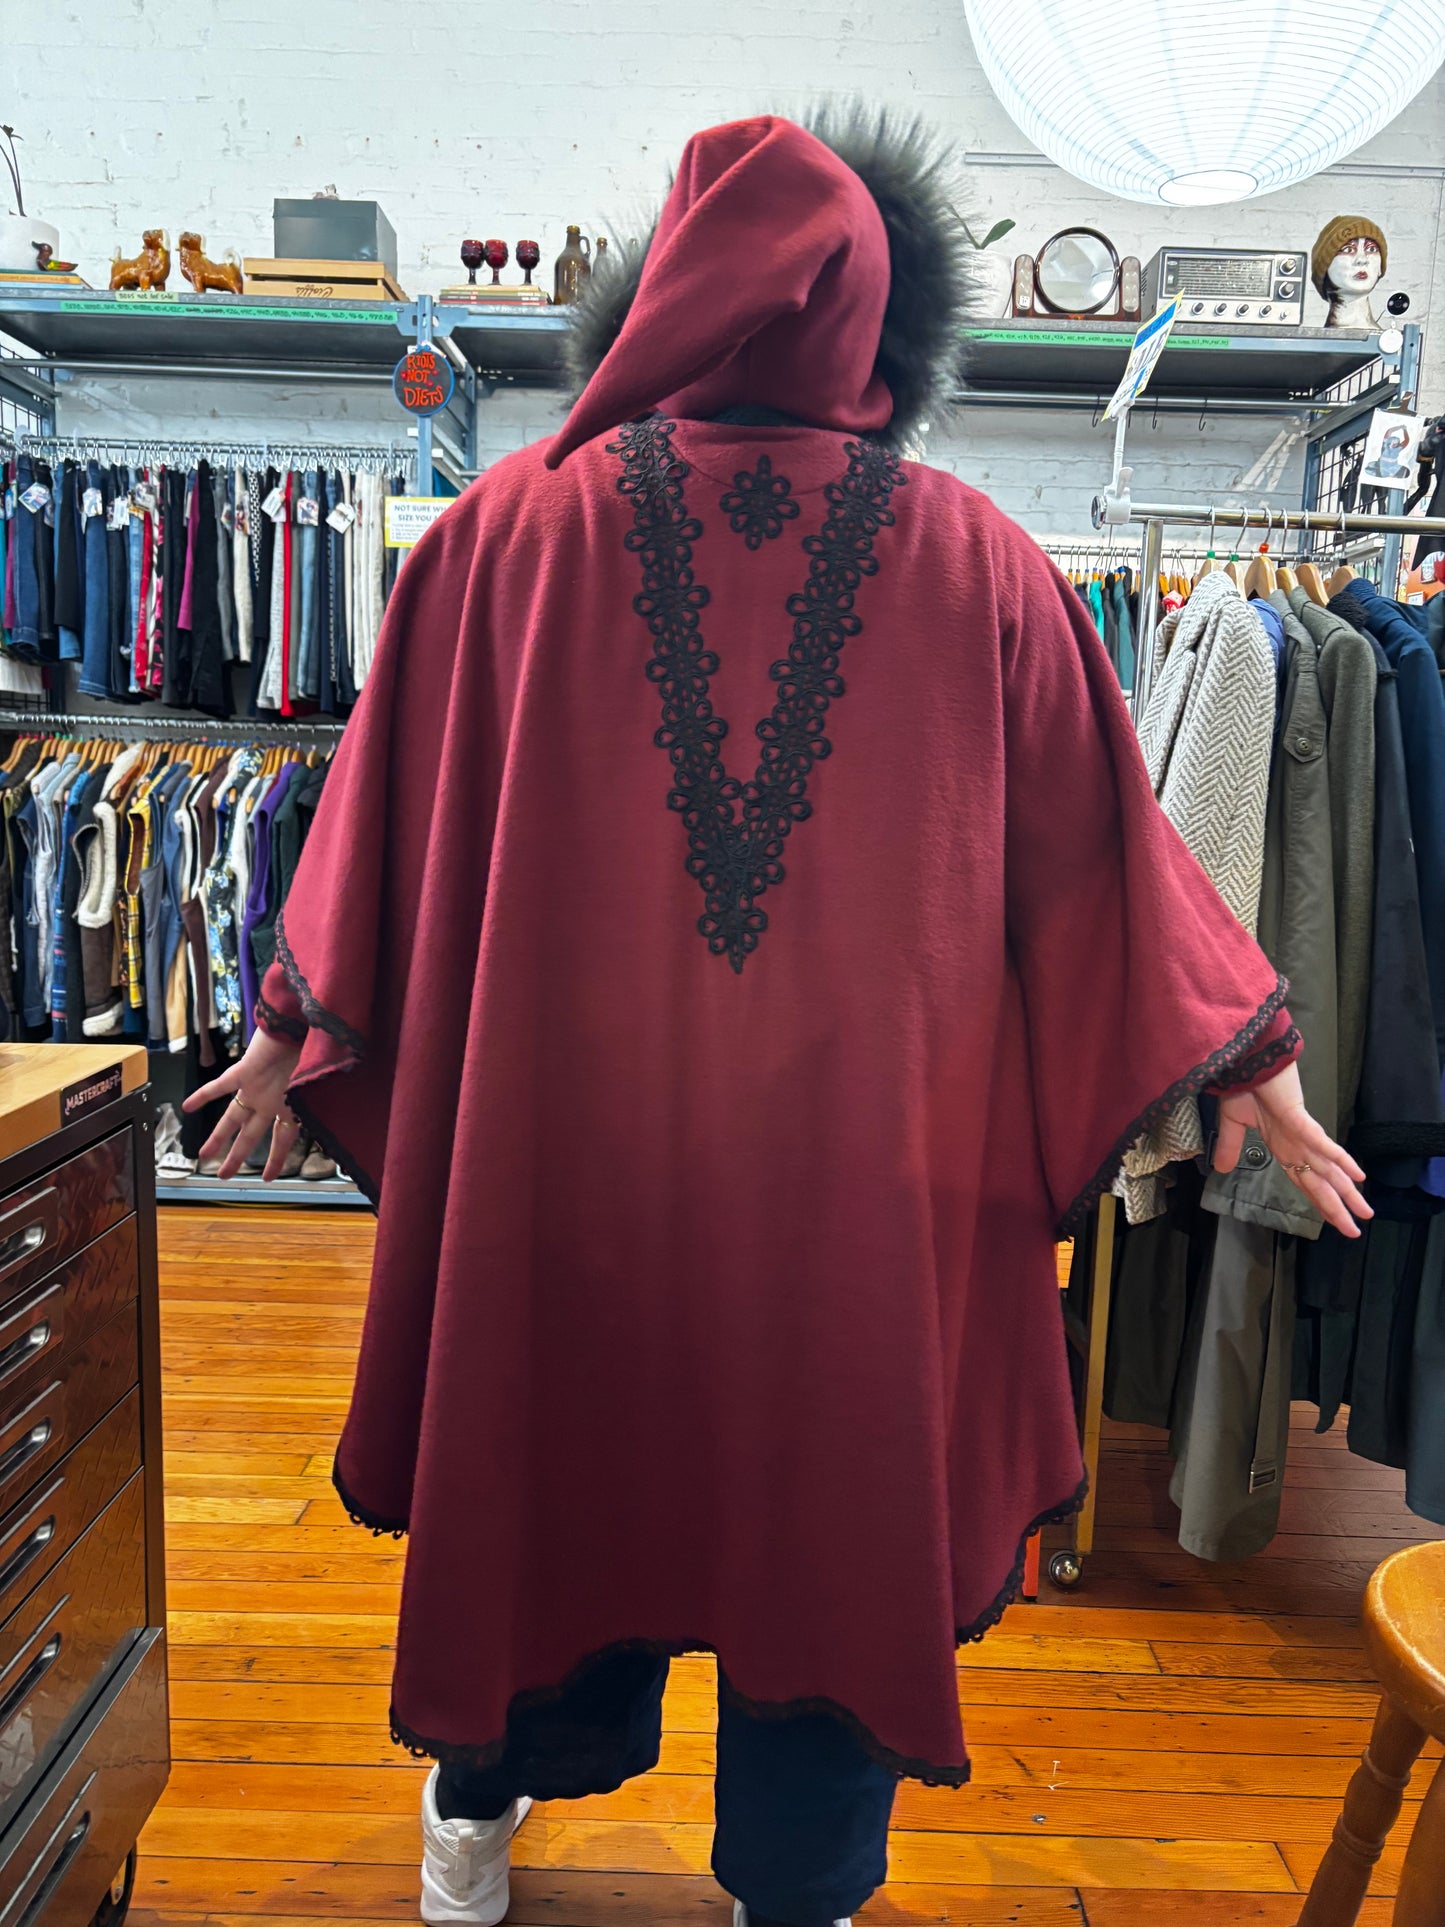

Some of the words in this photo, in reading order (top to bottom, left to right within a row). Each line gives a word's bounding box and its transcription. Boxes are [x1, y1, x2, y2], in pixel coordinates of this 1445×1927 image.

[406, 352, 435, 369] RIOTS
[407, 369, 430, 384] NOT
[403, 385, 443, 407] DIETS
[66, 1074, 121, 1109] MASTERCRAFT
